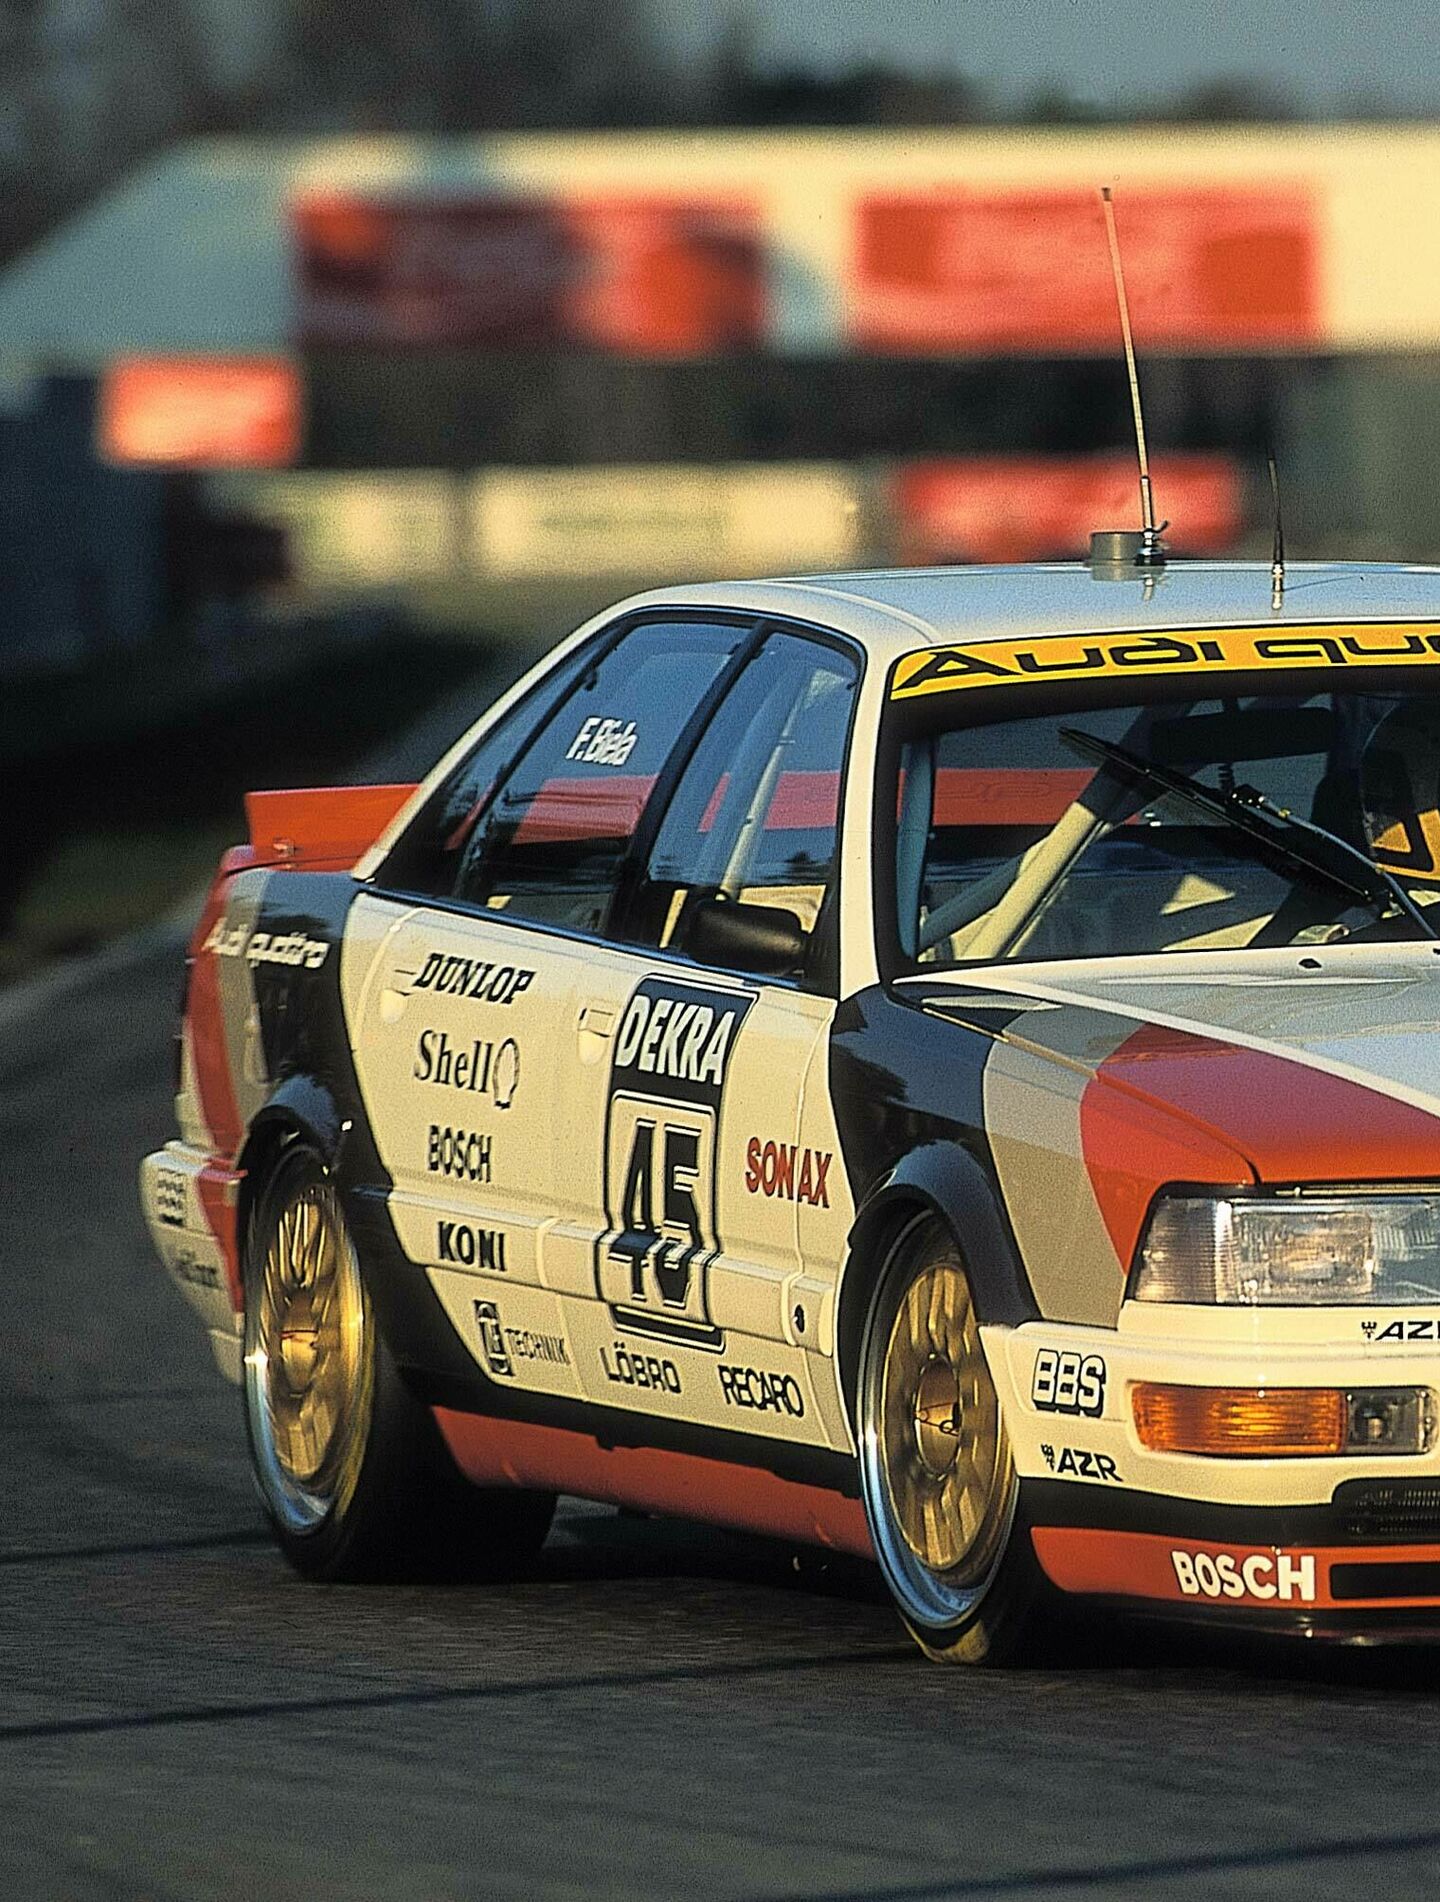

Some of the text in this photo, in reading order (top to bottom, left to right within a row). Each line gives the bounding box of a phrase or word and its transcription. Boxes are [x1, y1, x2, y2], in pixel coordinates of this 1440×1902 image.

[906, 637, 1226, 689] Audi
[413, 953, 537, 1005] DUNLOP
[413, 1029, 494, 1094] Shell
[614, 994, 736, 1086] DEKRA
[427, 1125, 492, 1183] BOSCH
[745, 1137, 833, 1210] SONAX
[606, 1117, 704, 1309] 45
[437, 1220, 506, 1272] KONI
[600, 1342, 682, 1395] LÖBRO
[718, 1365, 805, 1418] RECARO
[1031, 1349, 1107, 1418] BBS
[1056, 1447, 1124, 1482] AZR
[1172, 1550, 1317, 1601] BOSCH
